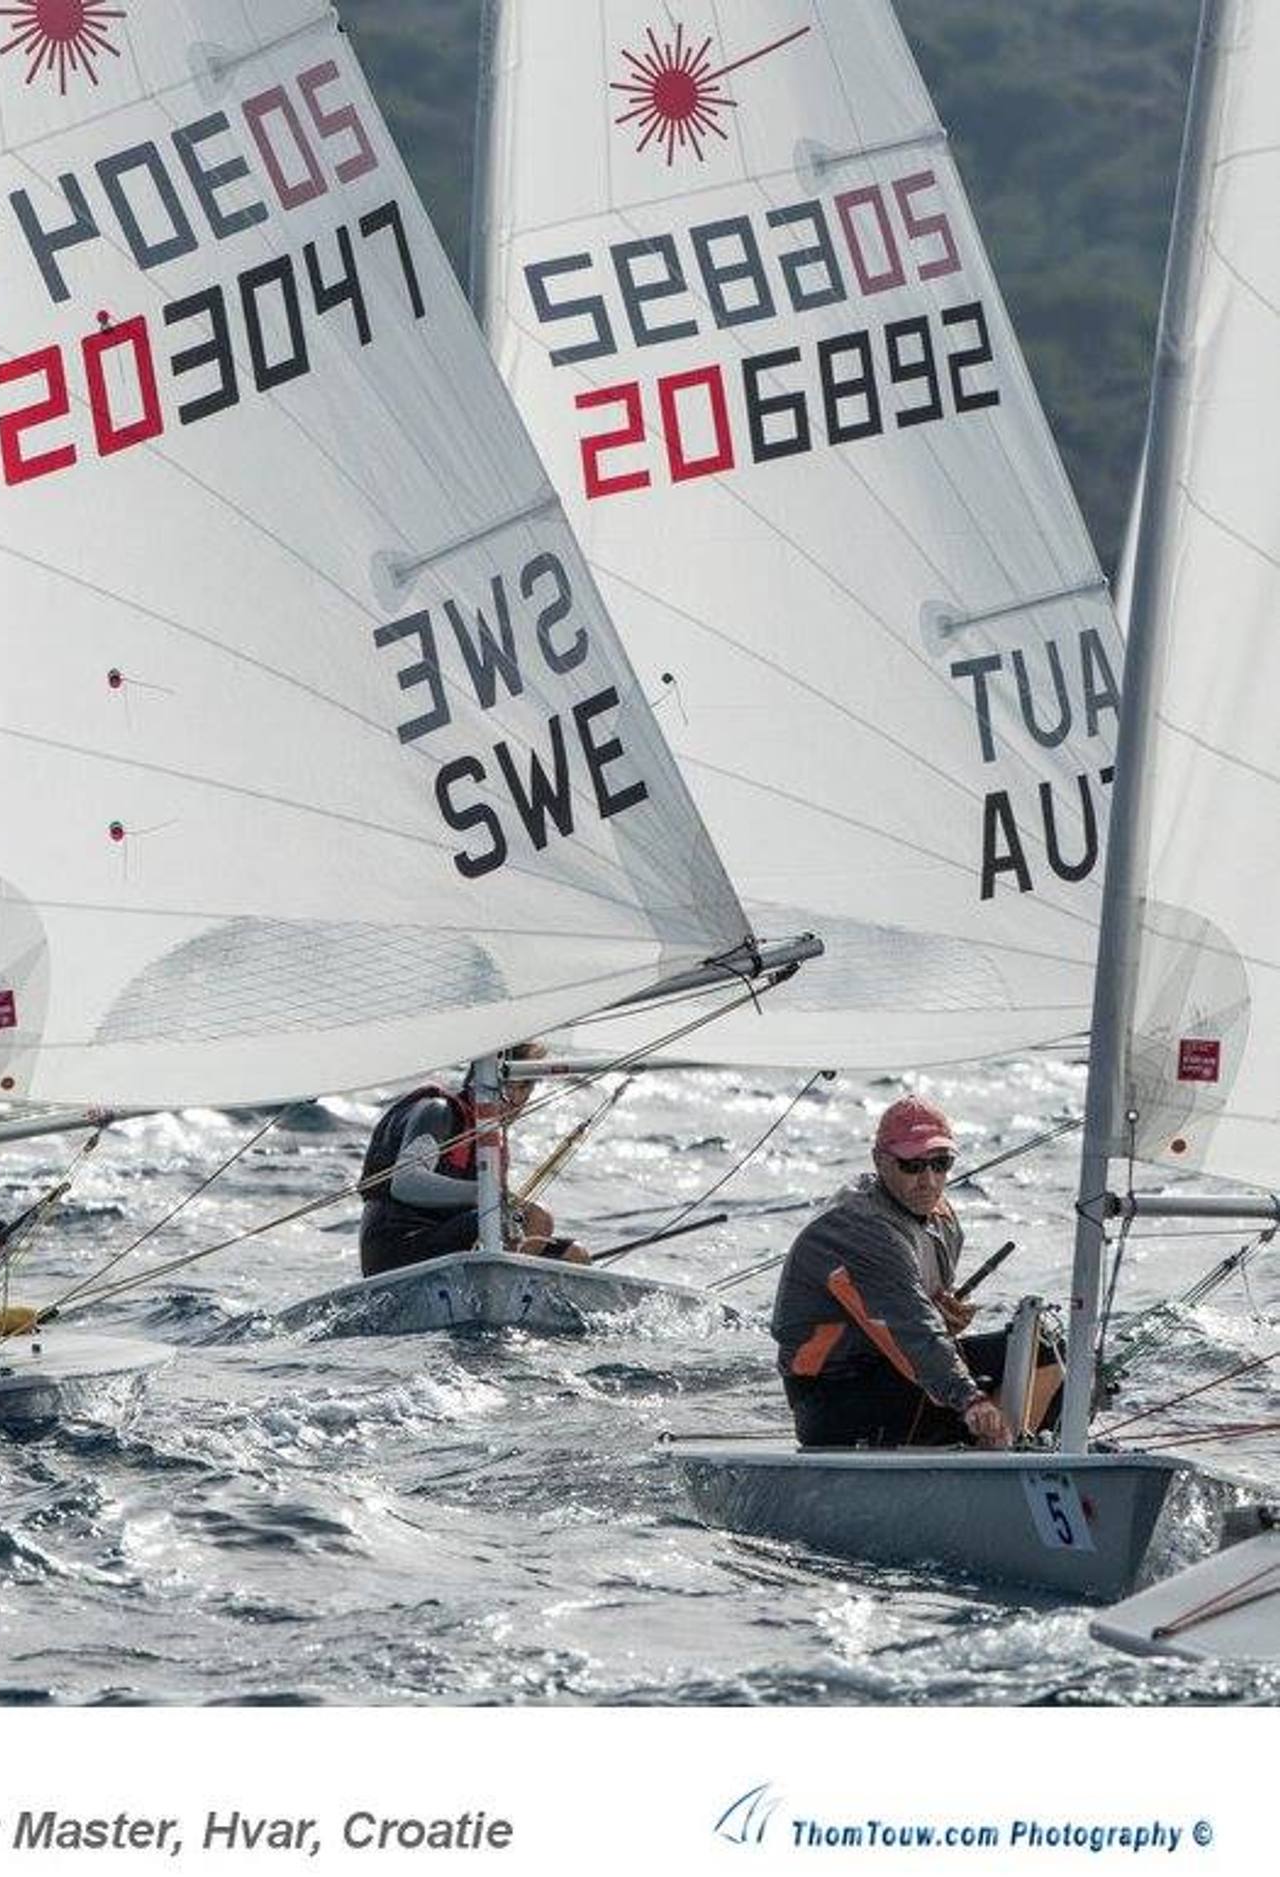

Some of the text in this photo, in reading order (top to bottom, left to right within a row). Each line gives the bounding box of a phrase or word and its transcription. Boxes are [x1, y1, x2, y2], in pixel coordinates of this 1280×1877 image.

[574, 301, 1000, 500] 206892
[434, 686, 649, 880] SWE
[1045, 1492, 1074, 1545] 5
